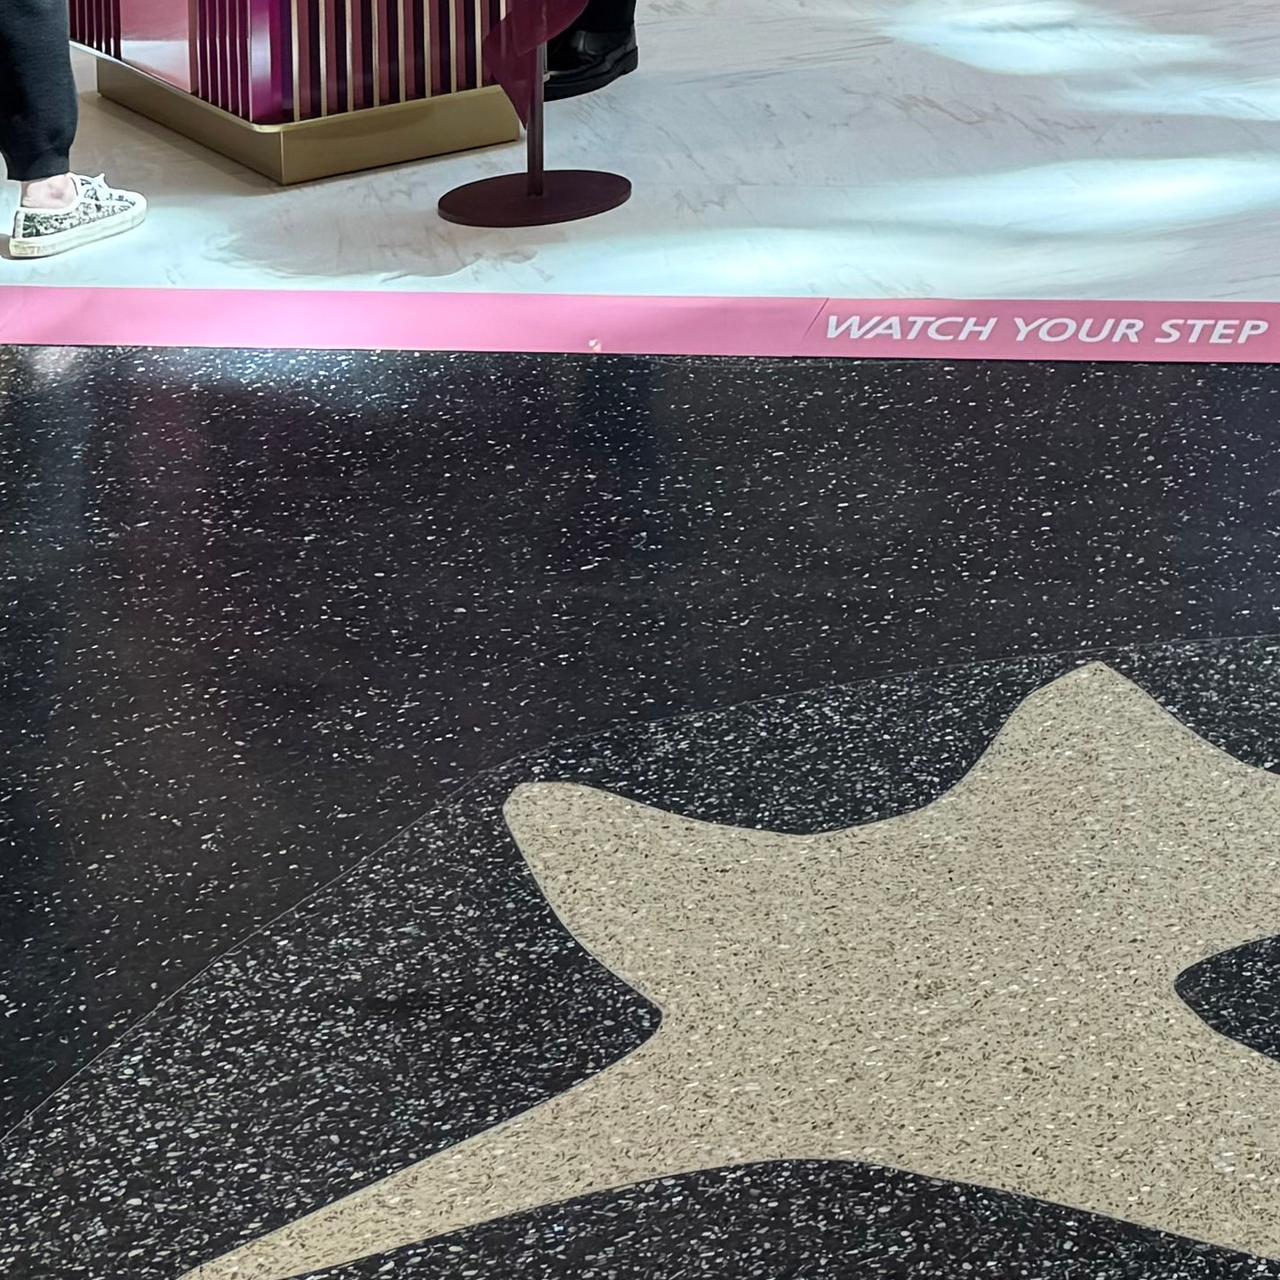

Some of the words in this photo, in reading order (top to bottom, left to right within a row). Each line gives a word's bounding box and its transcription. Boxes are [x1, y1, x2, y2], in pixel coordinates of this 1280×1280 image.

[826, 315, 998, 341] WATCH
[1013, 317, 1145, 343] YOUR
[1154, 319, 1269, 344] STEP
